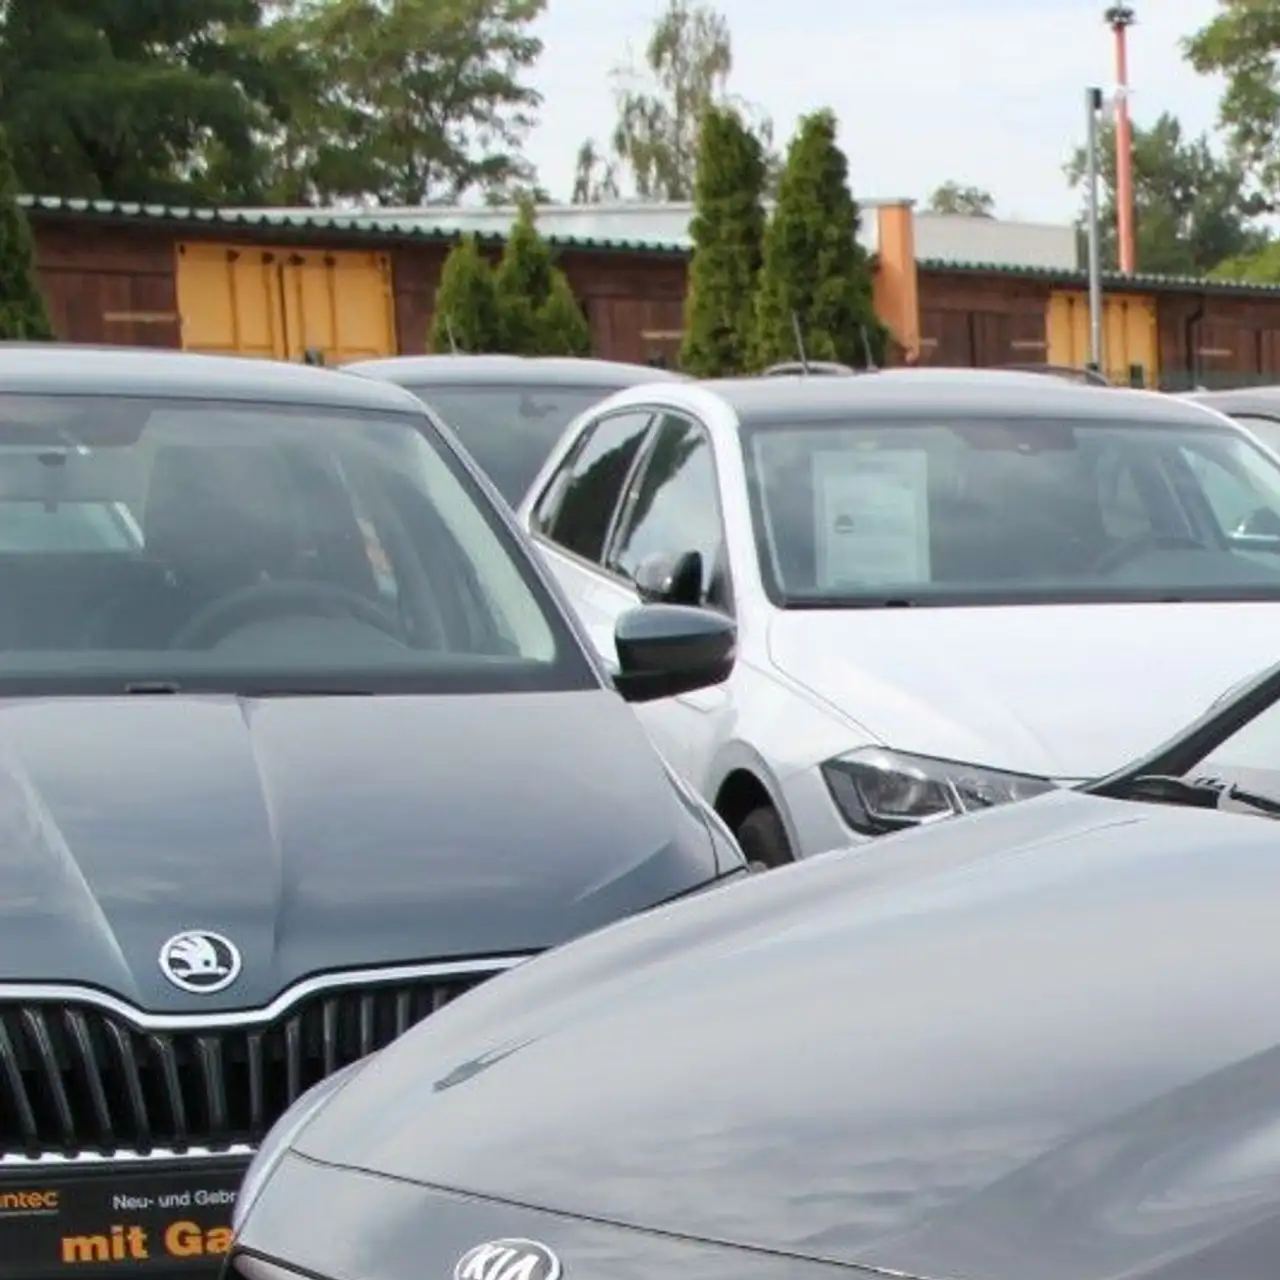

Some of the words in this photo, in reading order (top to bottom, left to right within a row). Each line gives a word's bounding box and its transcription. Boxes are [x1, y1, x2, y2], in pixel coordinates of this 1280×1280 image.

[112, 1195, 154, 1210] Neu-
[158, 1192, 191, 1207] und
[61, 1224, 148, 1262] mit
